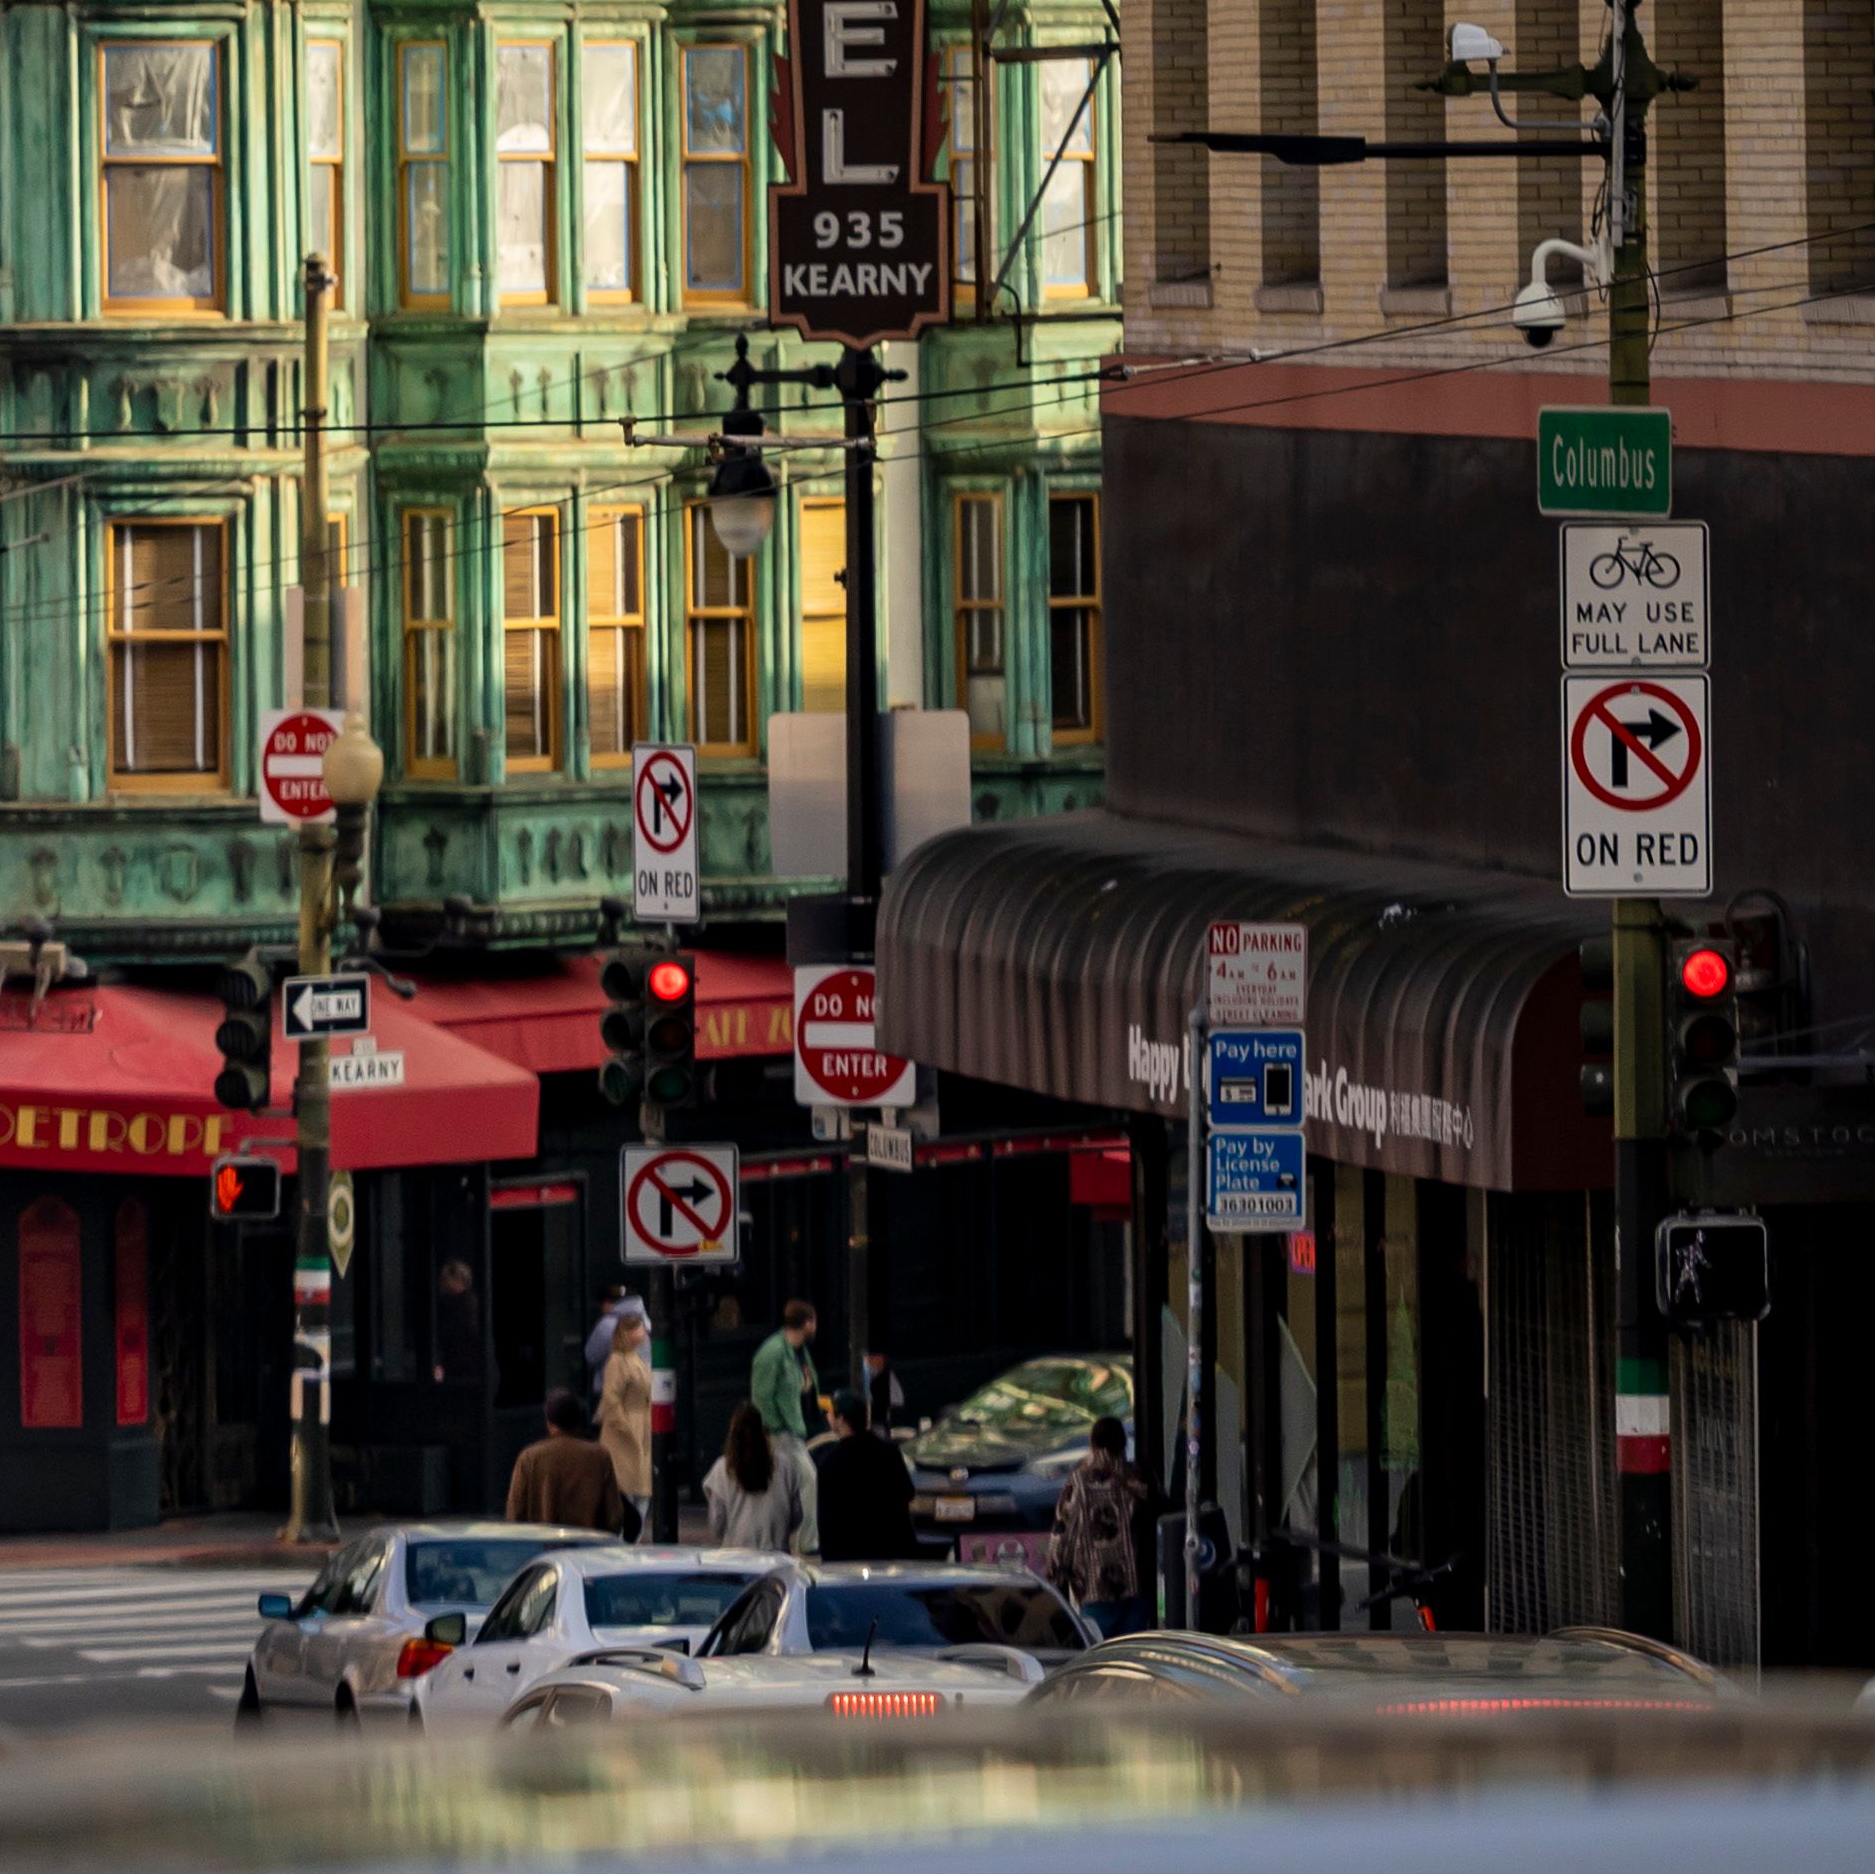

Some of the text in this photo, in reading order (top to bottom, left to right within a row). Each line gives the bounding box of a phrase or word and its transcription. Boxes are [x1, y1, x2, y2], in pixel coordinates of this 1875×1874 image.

[813, 211, 905, 248] 935
[784, 263, 933, 296] KEARNY
[1552, 433, 1656, 490] Columbus
[1576, 602, 1695, 624] MAY USE
[1572, 633, 1700, 654] FULL LANE
[274, 731, 297, 751] DO
[1576, 832, 1699, 866] ON RED
[638, 869, 693, 898] ON RED
[1212, 927, 1302, 953] NO PARKING
[1216, 960, 1226, 980] 4
[1267, 961, 1278, 981] 6
[335, 997, 357, 1011] WAY
[814, 993, 843, 1017] DO
[1216, 1038, 1297, 1062] Pay here
[332, 1058, 399, 1082] KEARNY
[822, 1053, 887, 1078] ENTER
[1128, 1024, 1179, 1103] Happy
[1335, 1065, 1388, 1149] Group
[870, 1132, 909, 1163] COLUMBUS
[1216, 1137, 1274, 1157] Pay by
[1216, 1158, 1280, 1172] License
[1216, 1174, 1260, 1191] Plate
